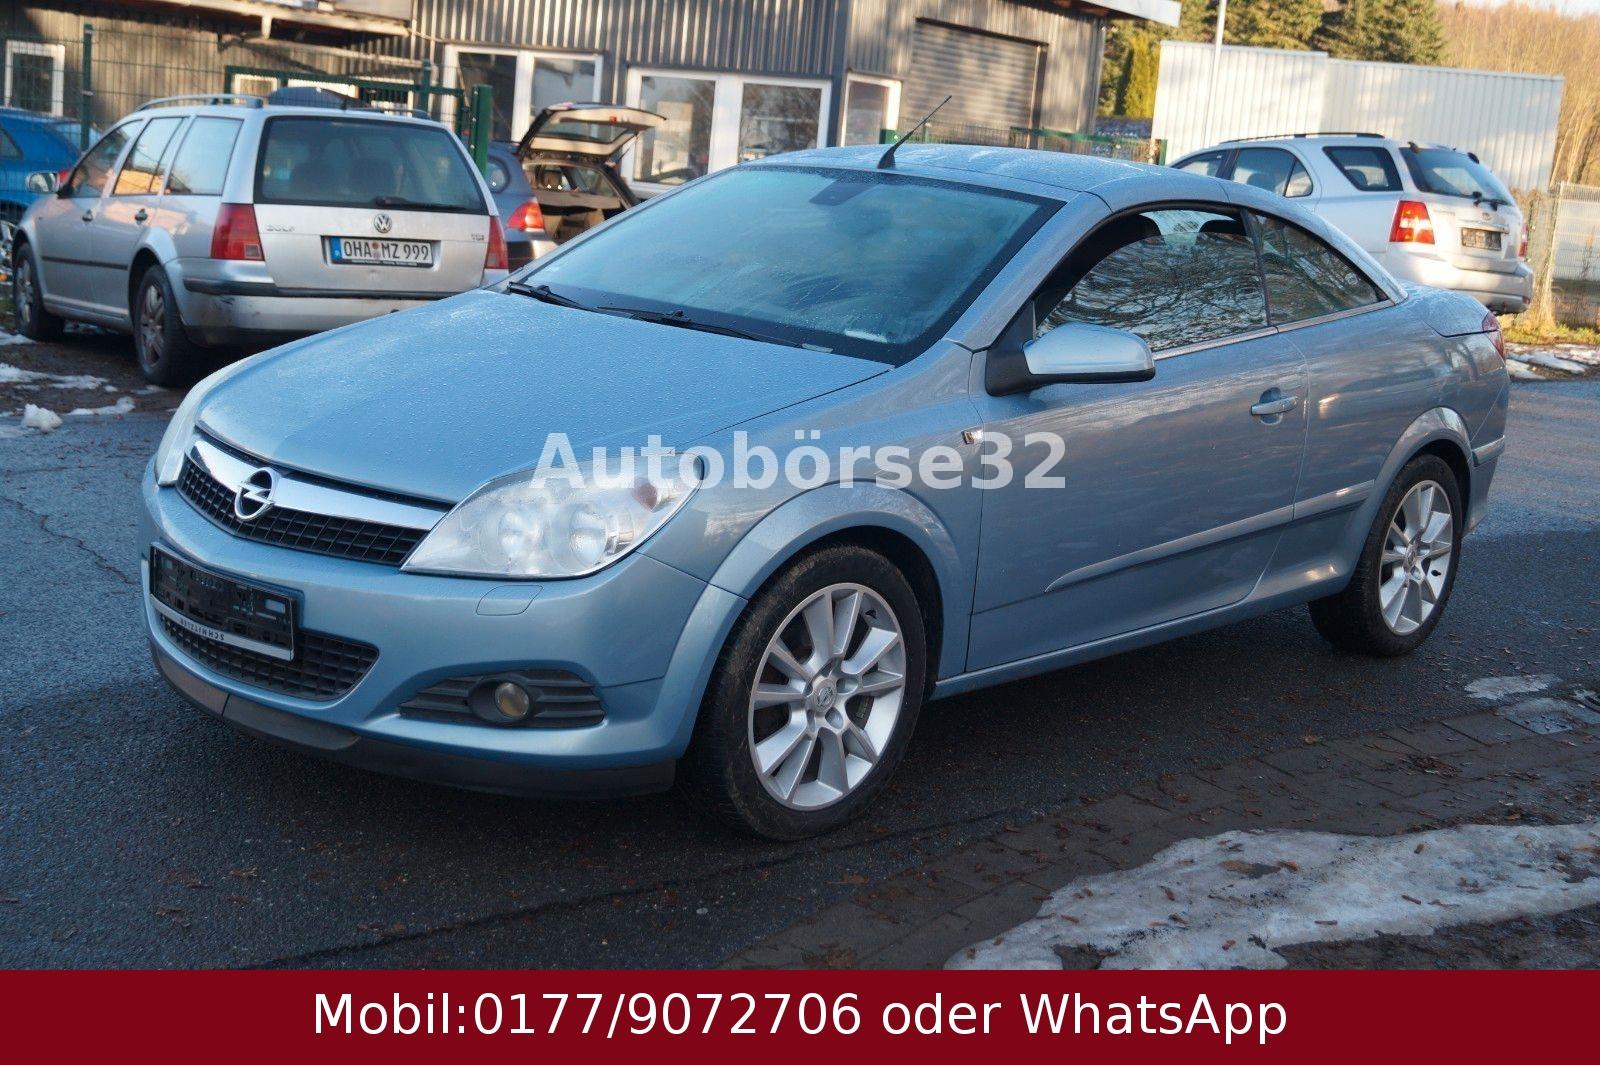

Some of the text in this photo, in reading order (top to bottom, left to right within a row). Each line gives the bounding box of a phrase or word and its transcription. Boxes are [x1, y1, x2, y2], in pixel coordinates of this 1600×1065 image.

[343, 241, 429, 260] OHA MZ 999
